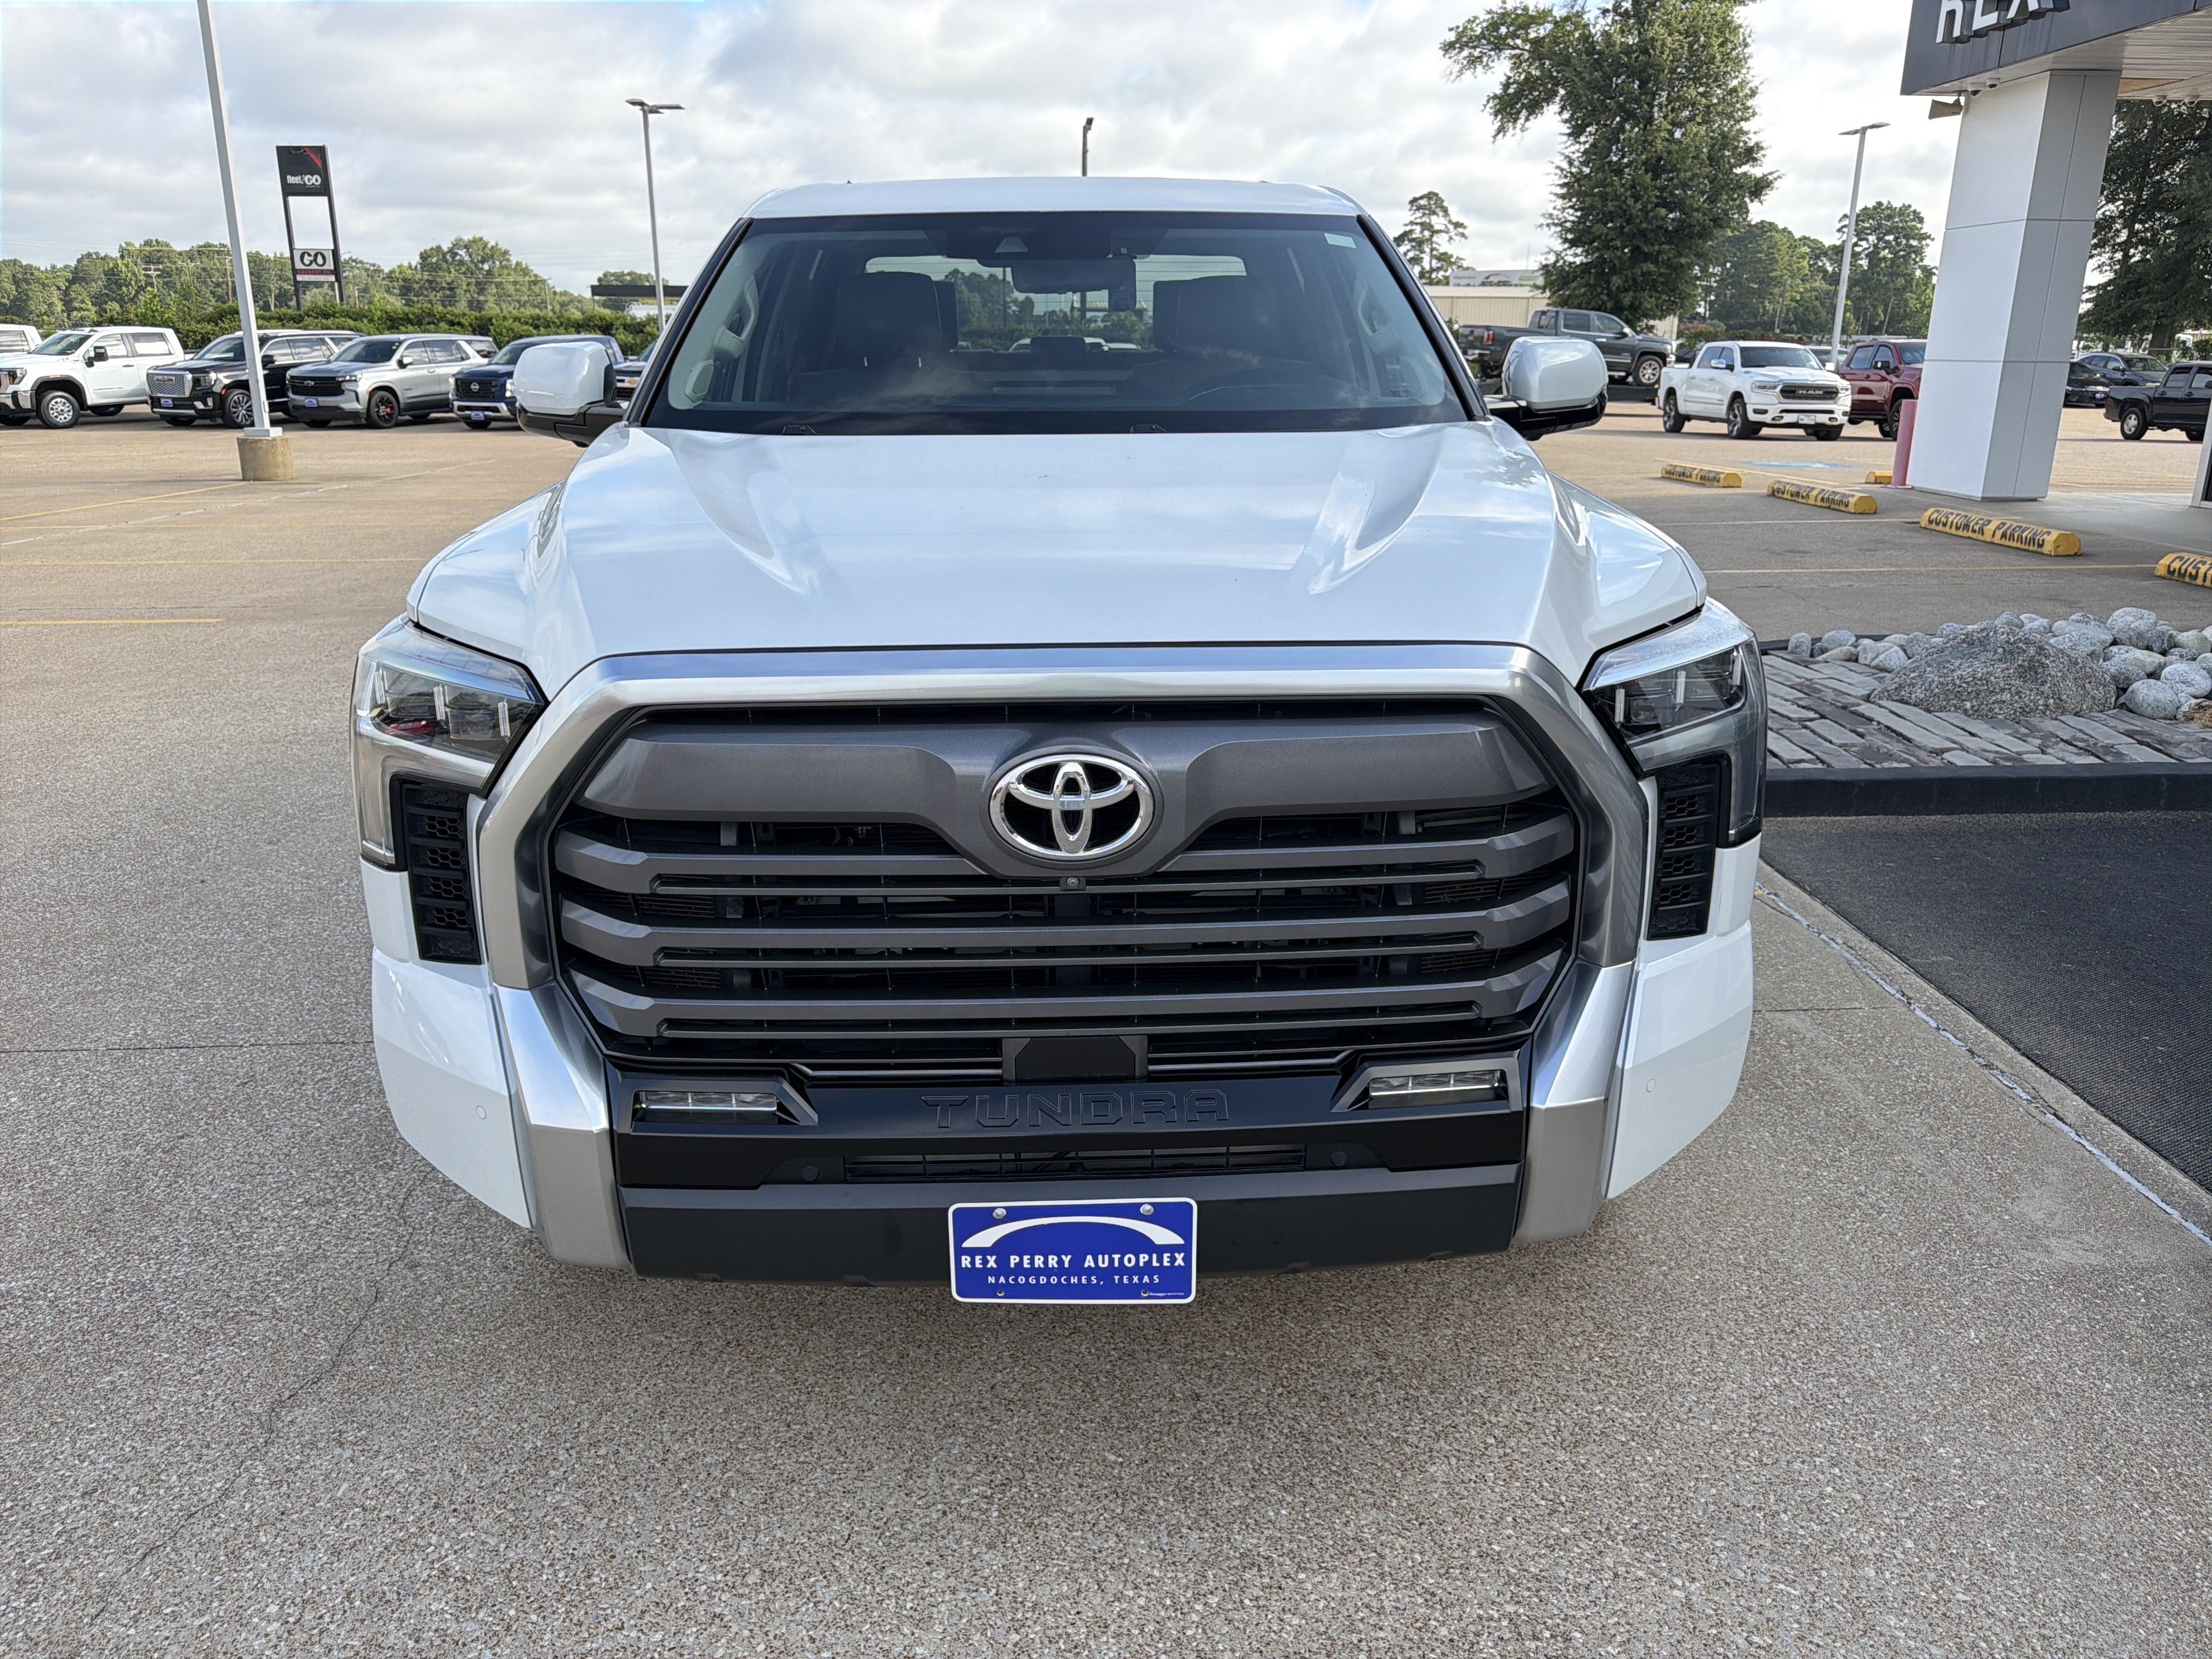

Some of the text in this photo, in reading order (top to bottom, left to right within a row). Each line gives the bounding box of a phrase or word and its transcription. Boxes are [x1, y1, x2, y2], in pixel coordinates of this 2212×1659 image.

[300, 251, 327, 267] GO
[1928, 509, 2052, 549] CUSTOMER PARKING
[2167, 556, 2212, 584] CUST
[922, 1089, 1229, 1128] TUNDRA
[961, 1252, 1186, 1268] REX PERRY AUTOPLEX
[988, 1274, 1160, 1285] NACOGDOCHES, TEXAS
